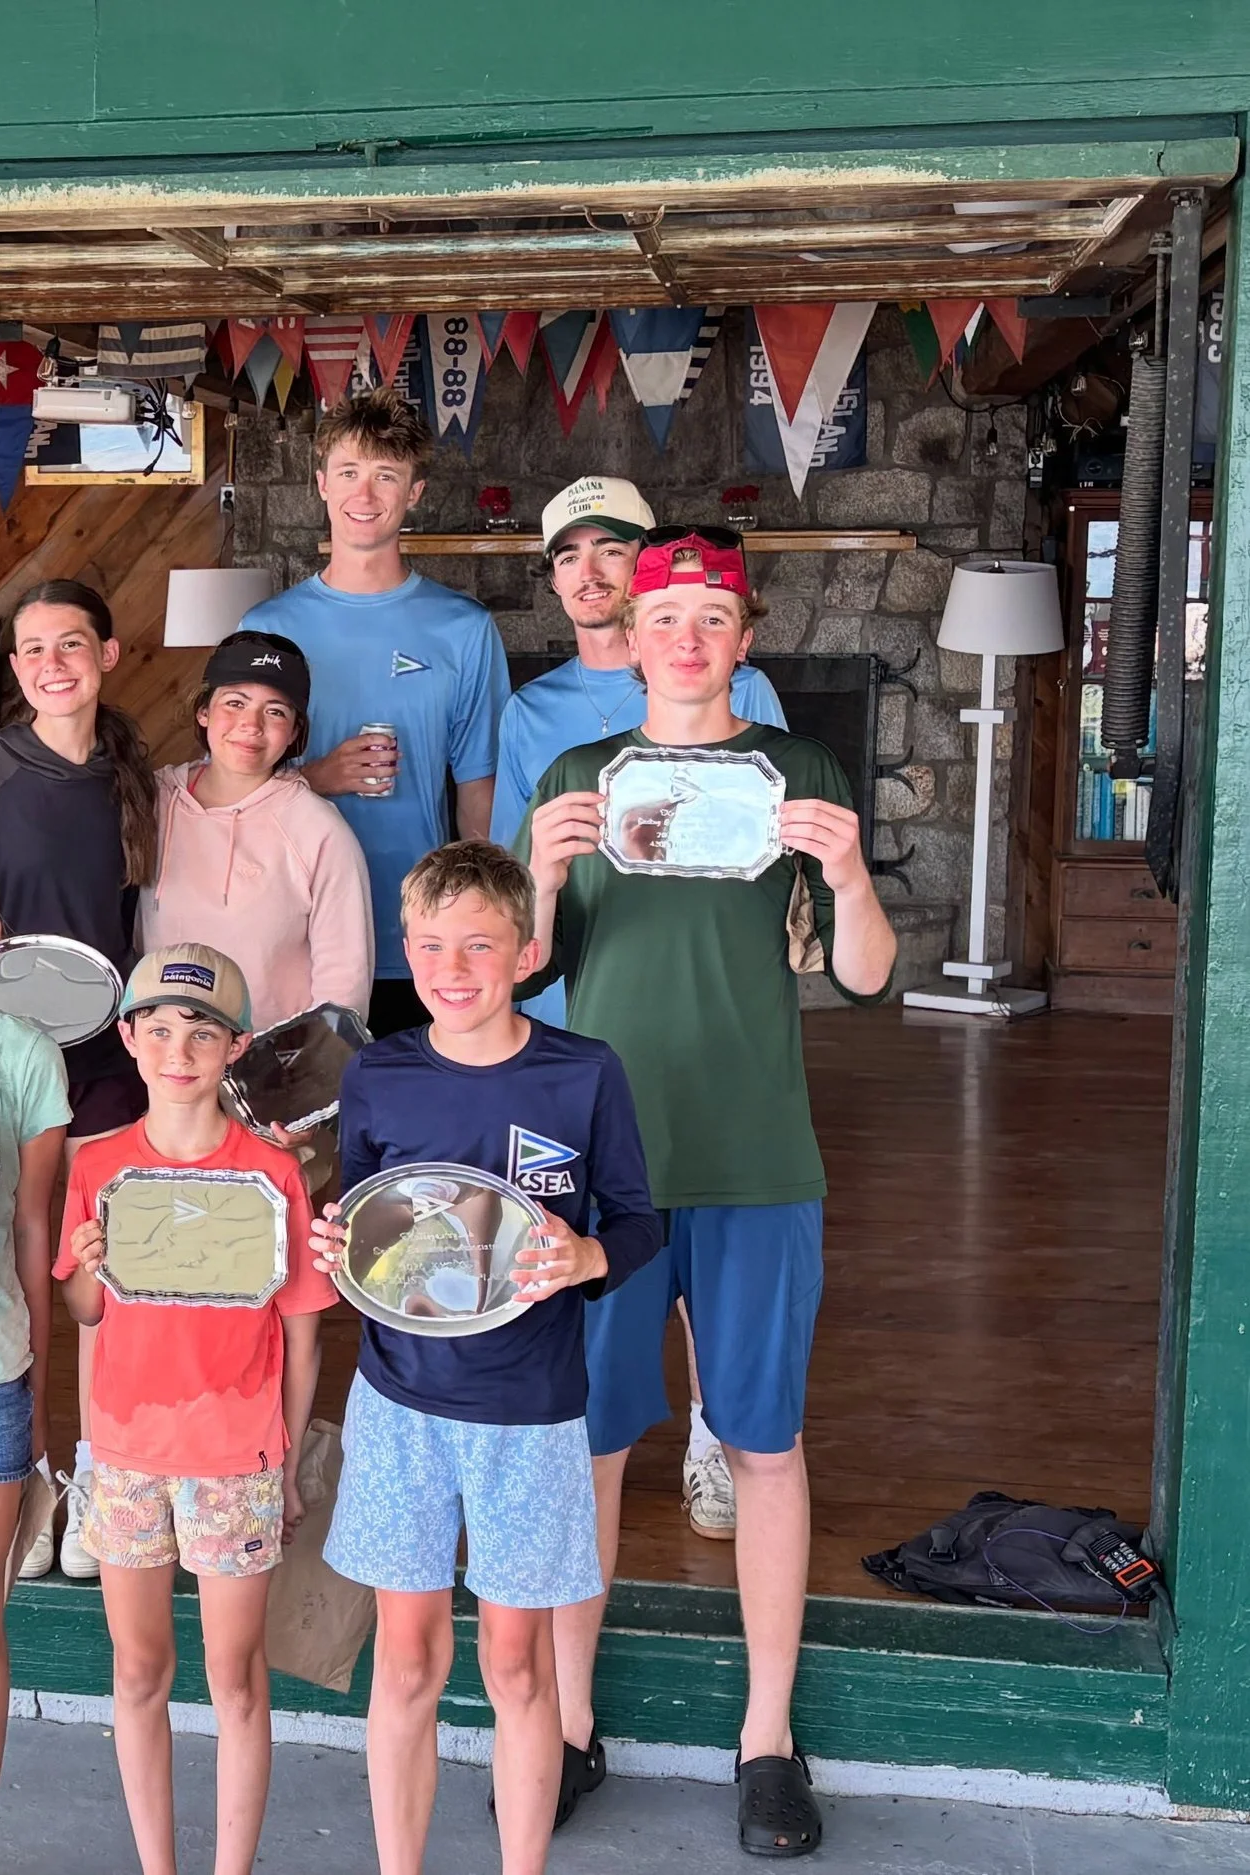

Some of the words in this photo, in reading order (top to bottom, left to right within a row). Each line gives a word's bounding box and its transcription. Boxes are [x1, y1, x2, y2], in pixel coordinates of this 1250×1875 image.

[442, 317, 468, 408] 88-88
[749, 345, 773, 406] 1994
[250, 653, 283, 671] zhik
[163, 973, 212, 988] patagonia
